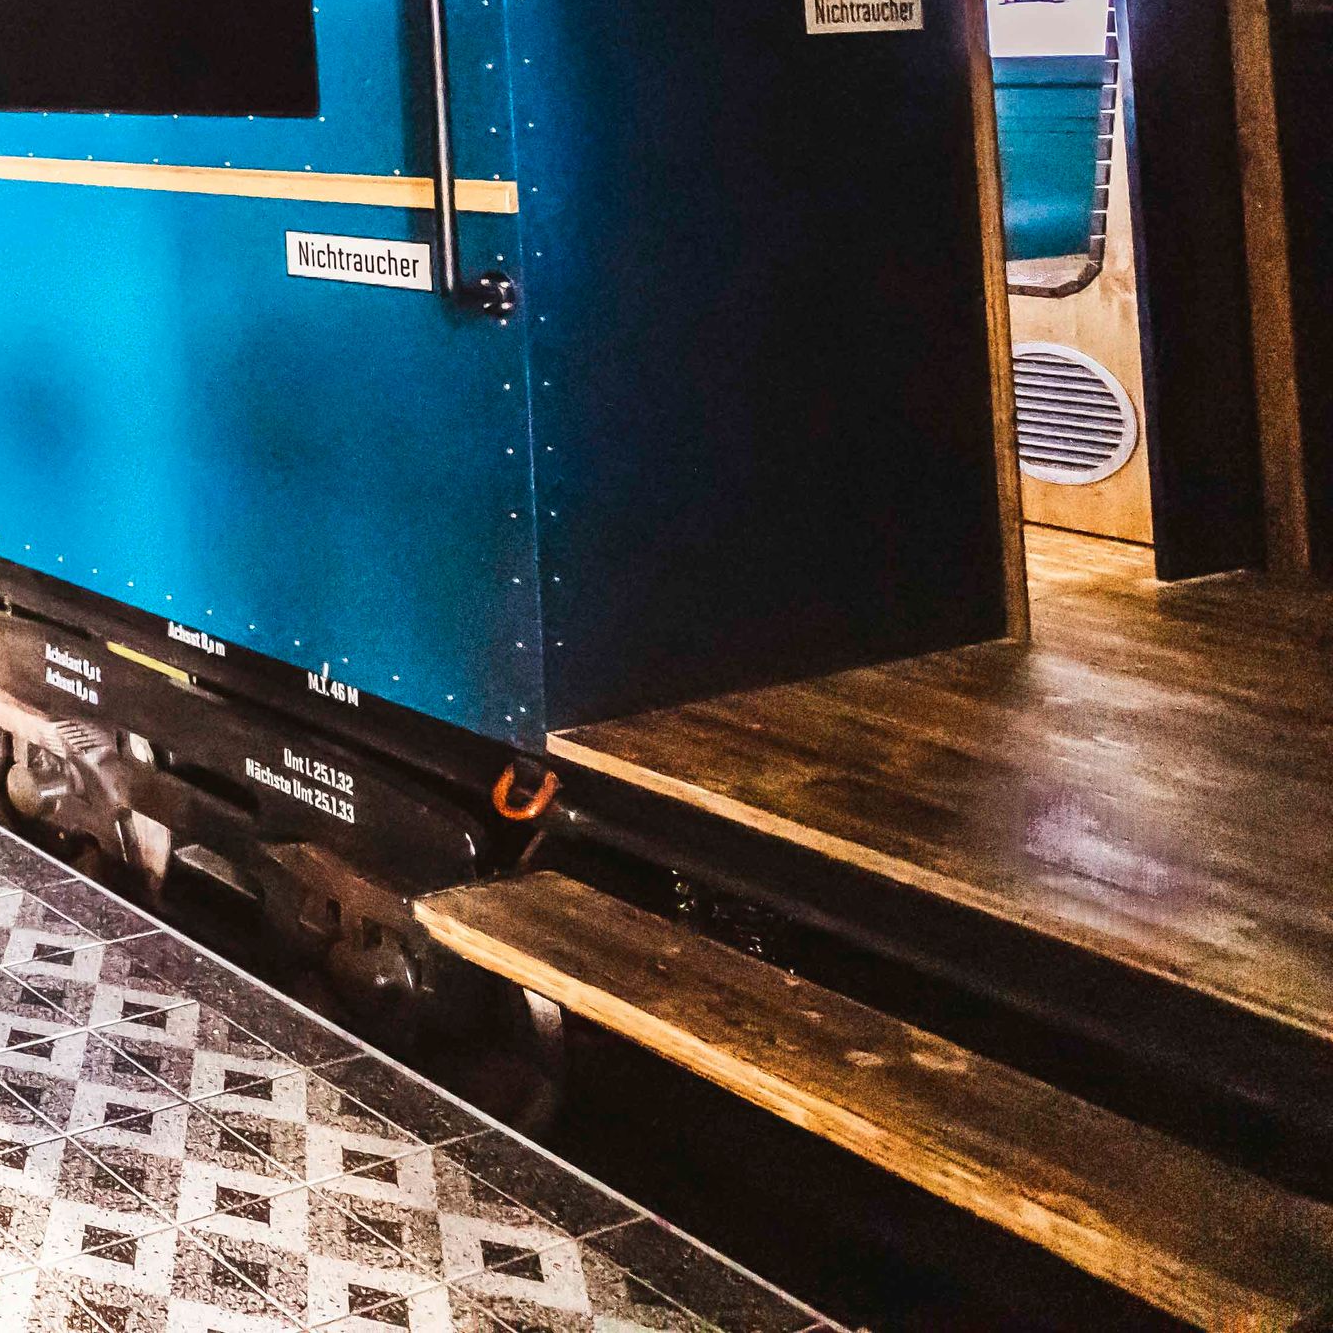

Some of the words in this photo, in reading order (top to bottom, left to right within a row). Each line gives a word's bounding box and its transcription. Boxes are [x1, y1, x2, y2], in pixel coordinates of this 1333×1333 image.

[298, 240, 420, 278] Nichtraucher
[330, 680, 346, 702] 46
[347, 685, 359, 707] M
[284, 747, 304, 774] Unt
[245, 757, 291, 795] Nächste
[292, 778, 313, 805] Unt
